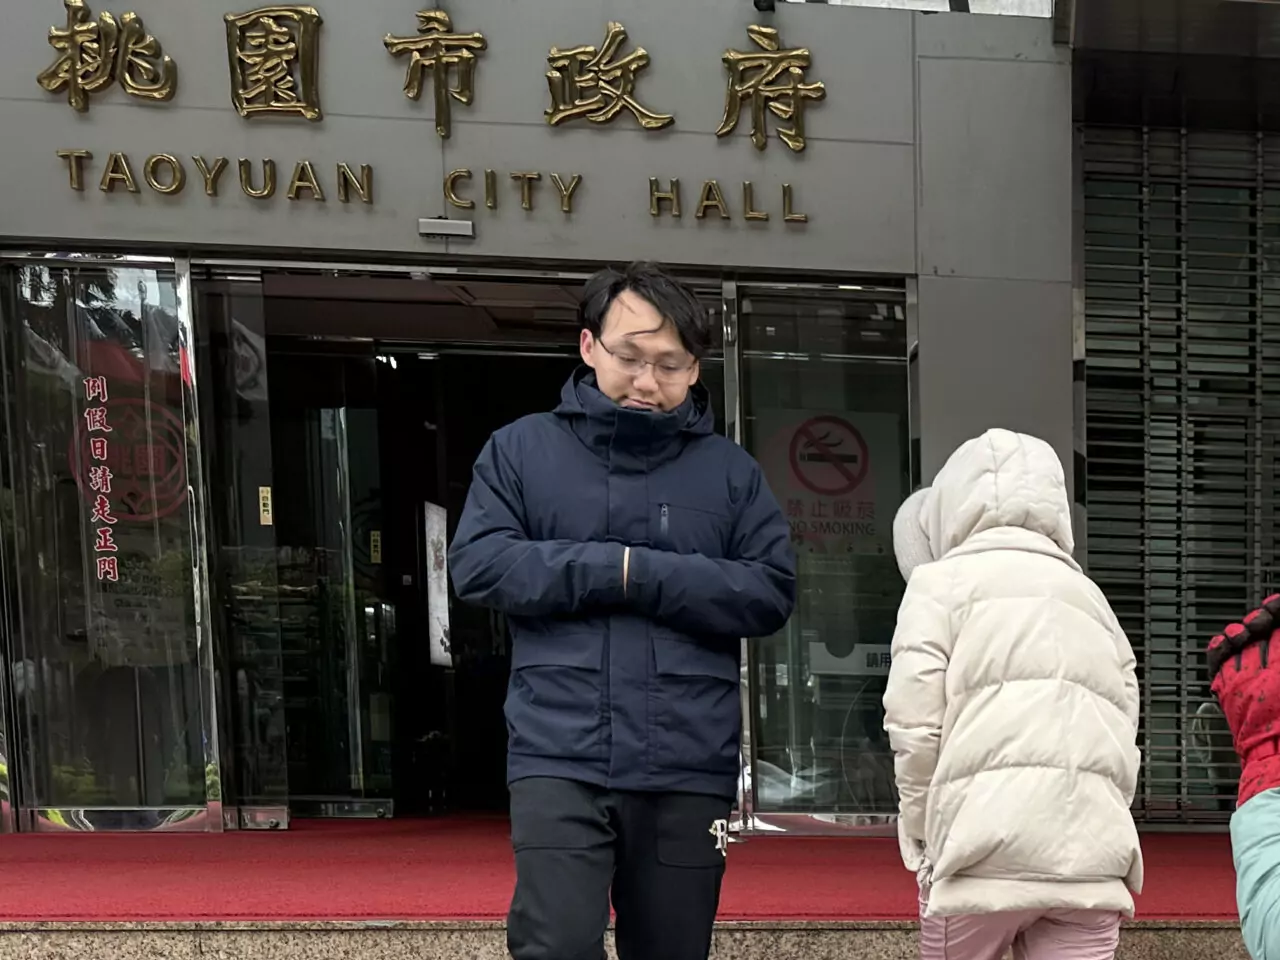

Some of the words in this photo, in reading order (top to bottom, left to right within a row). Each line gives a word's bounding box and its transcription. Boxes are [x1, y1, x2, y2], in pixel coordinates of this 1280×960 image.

[37, 0, 827, 152] 桃園市政府
[56, 148, 375, 204] TAOYUAN
[443, 168, 583, 214] CITY
[649, 176, 809, 223] HALL
[83, 375, 120, 582] 例假日請走正門
[787, 520, 807, 533] NO
[811, 521, 876, 536] SMOKING
